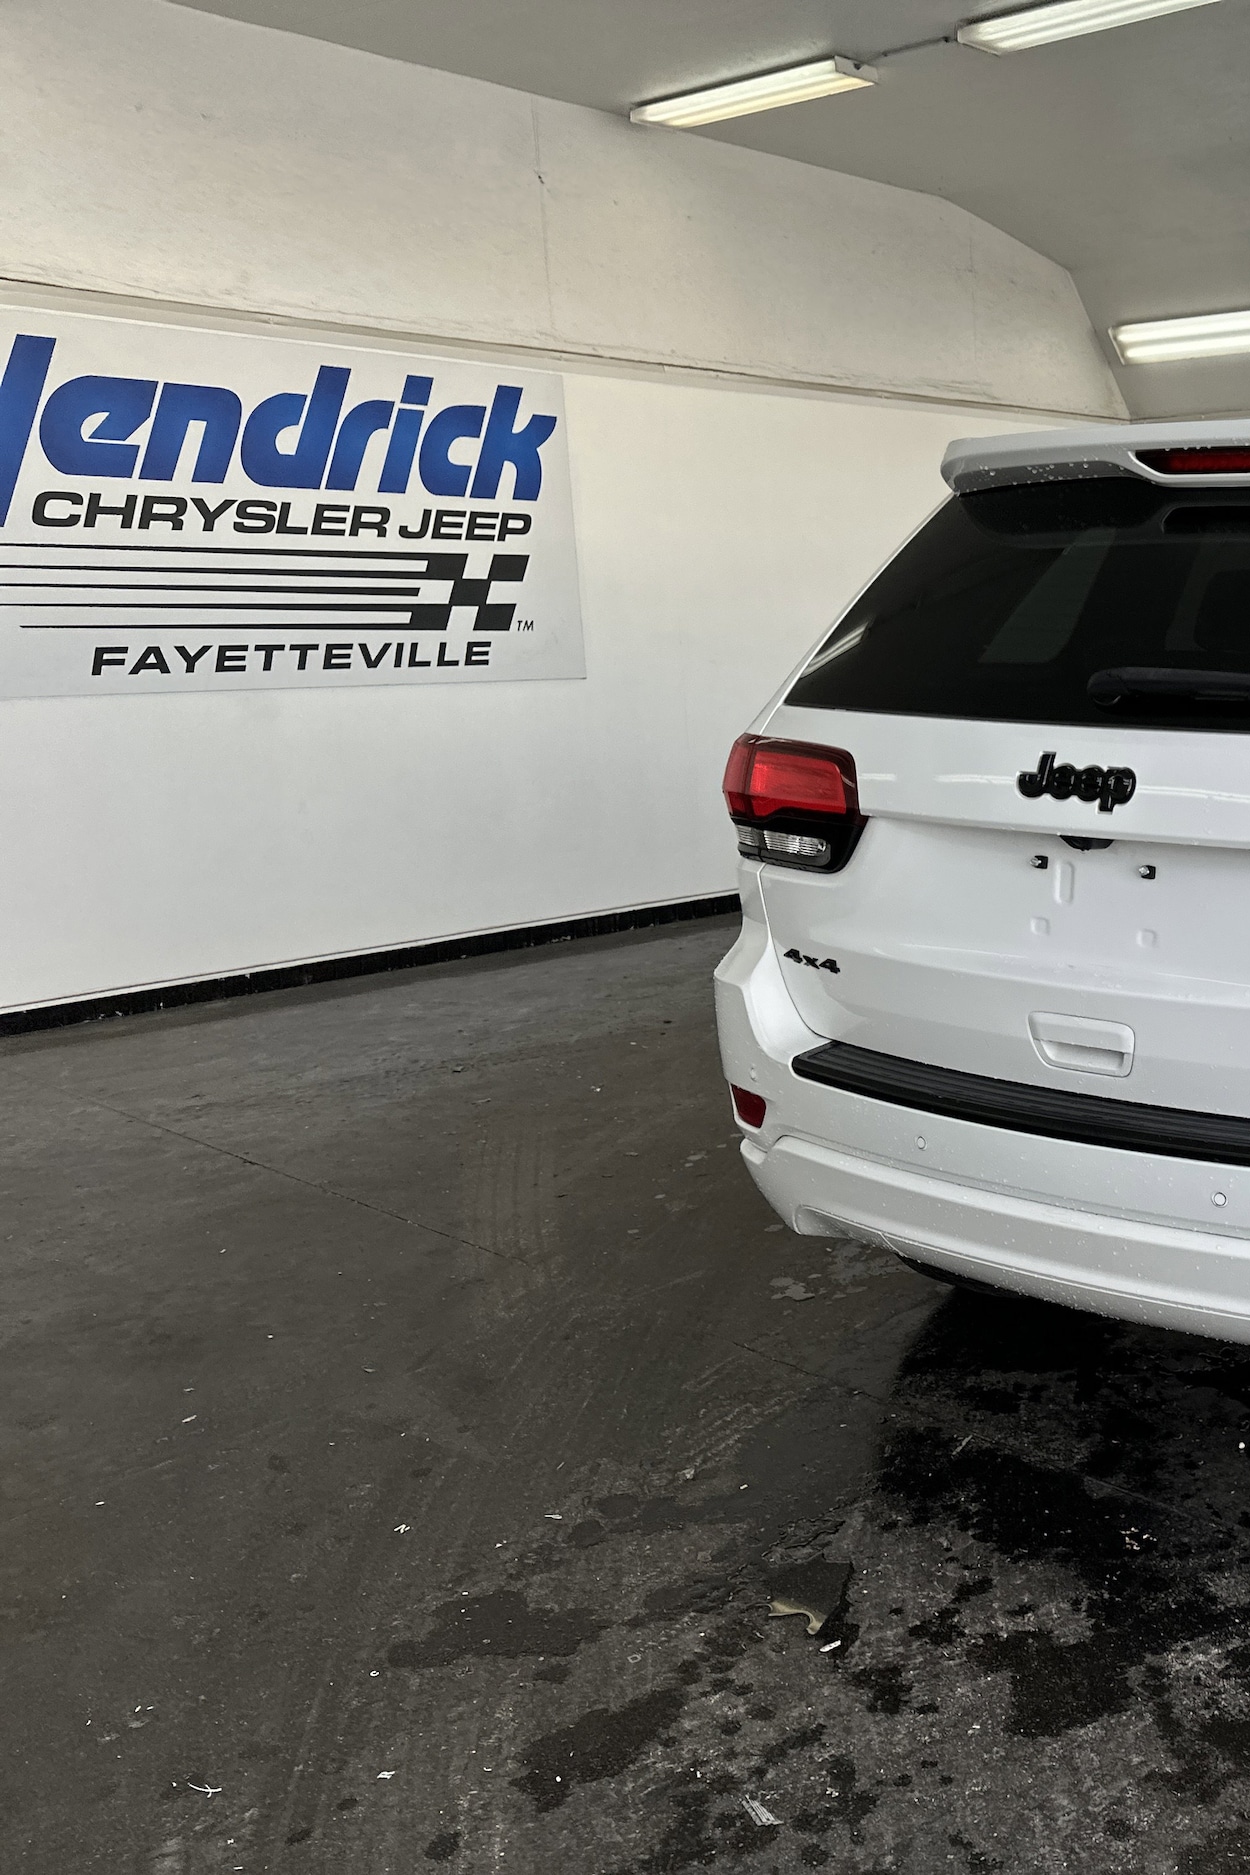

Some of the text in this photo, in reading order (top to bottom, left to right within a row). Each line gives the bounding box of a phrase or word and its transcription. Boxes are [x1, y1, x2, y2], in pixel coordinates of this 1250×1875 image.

[31, 490, 533, 542] CHRYSLER JEEP
[517, 620, 534, 631] TM
[91, 641, 492, 676] FAYETTEVILLE
[1016, 751, 1136, 814] Jeep
